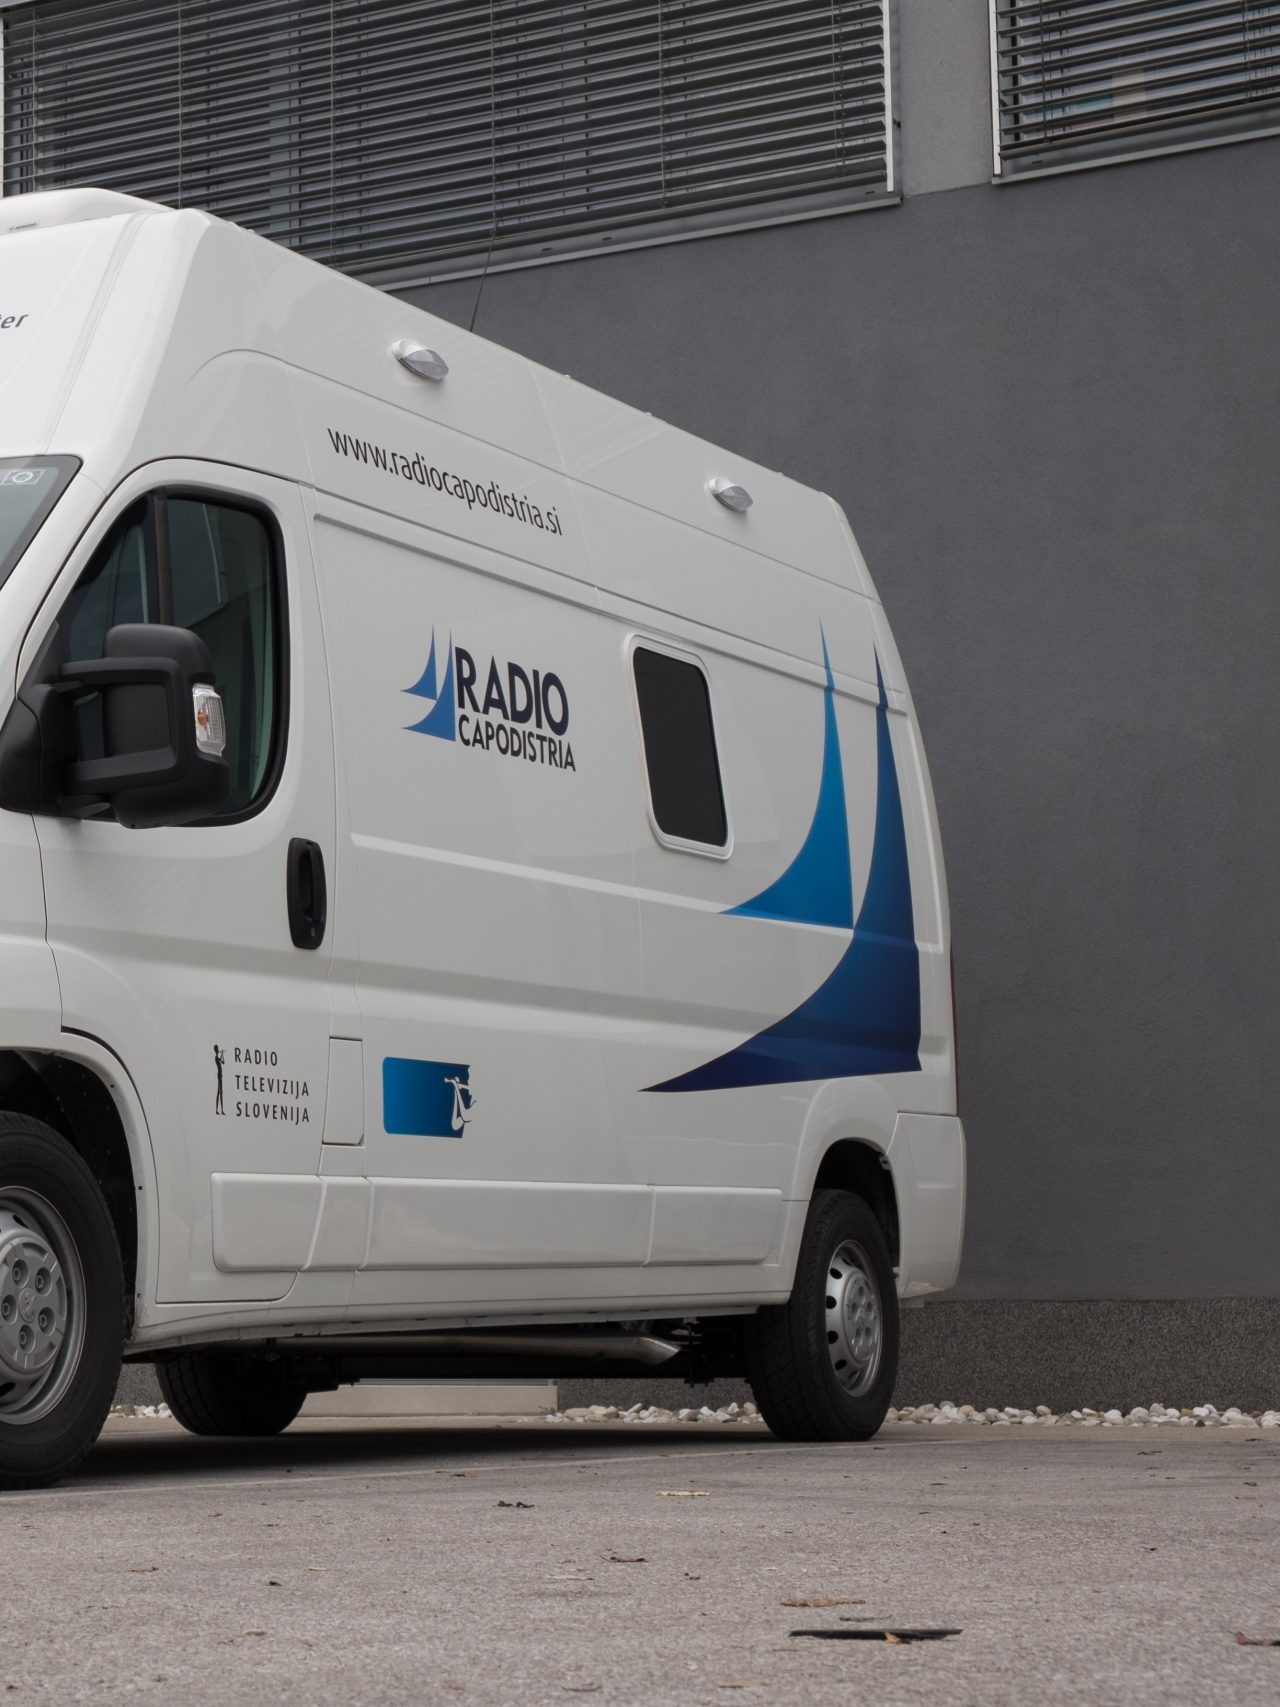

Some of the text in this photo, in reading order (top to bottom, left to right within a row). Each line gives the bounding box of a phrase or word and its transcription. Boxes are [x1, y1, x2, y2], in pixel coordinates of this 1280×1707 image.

[327, 428, 562, 536] www.radiocapodistria.si
[454, 646, 570, 736] RADIO
[458, 713, 576, 772] CAPODISTRIA
[234, 1047, 278, 1066] RADIO
[235, 1075, 308, 1099] TELEVIZIJA
[236, 1101, 308, 1125] SLOVENIJA
